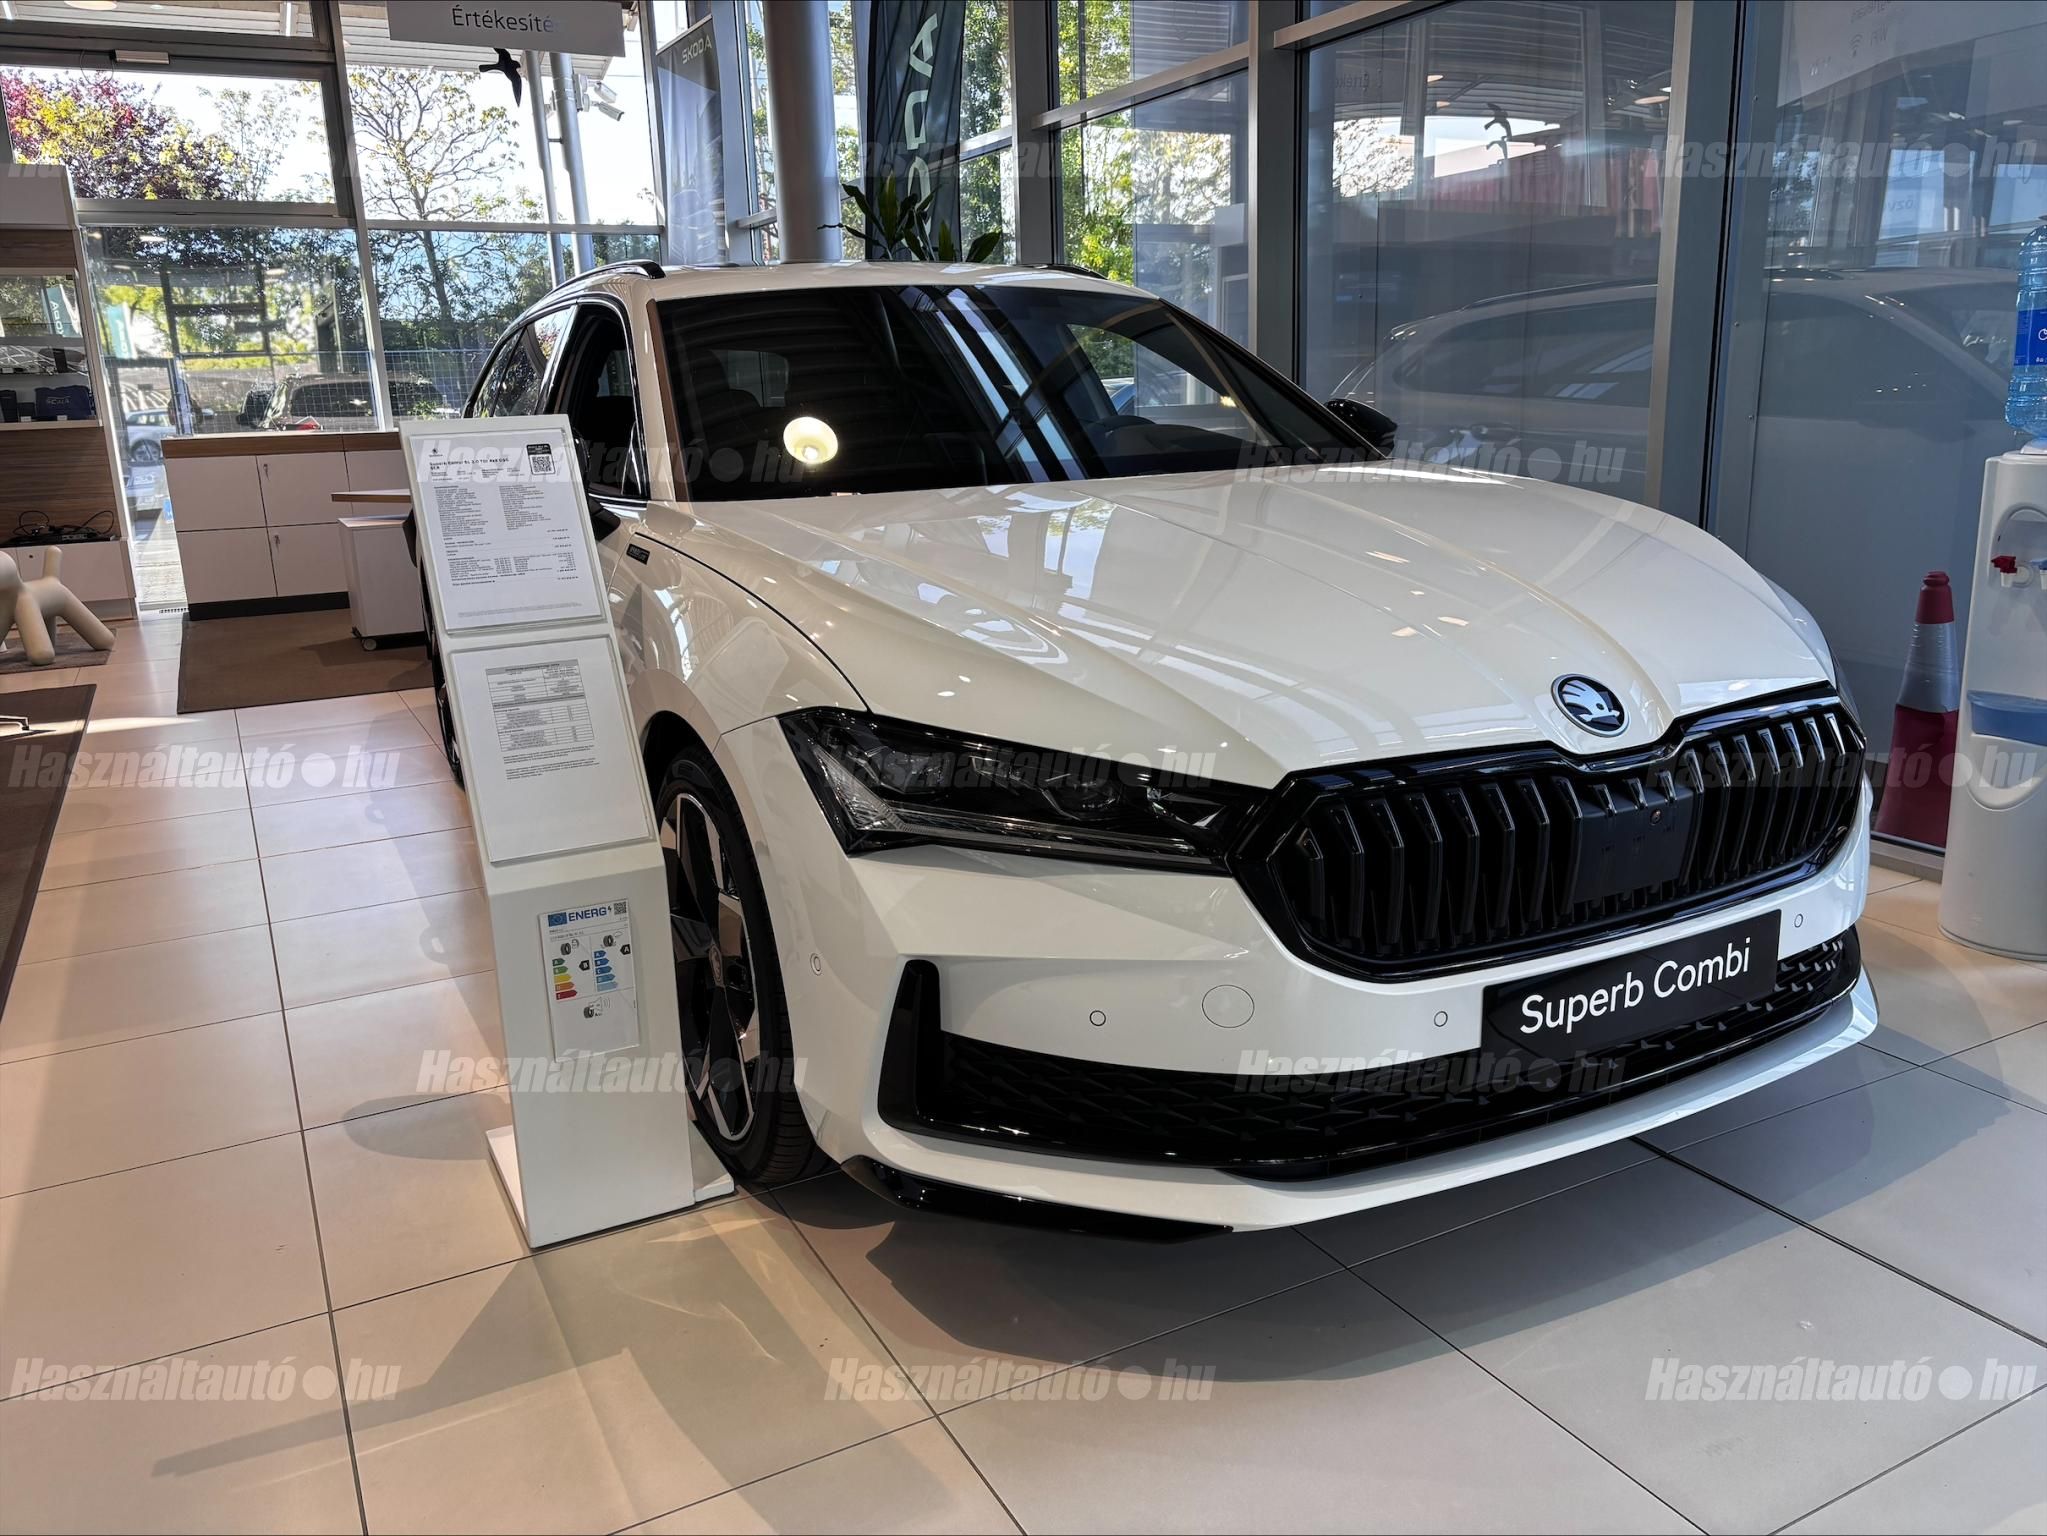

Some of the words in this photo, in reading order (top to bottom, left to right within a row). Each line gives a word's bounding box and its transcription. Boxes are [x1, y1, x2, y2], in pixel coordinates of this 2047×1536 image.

[452, 5, 558, 33] Értékesíté
[568, 906, 608, 922] ENERG
[1520, 972, 1644, 1034] Superb
[1653, 937, 1750, 998] Combi
